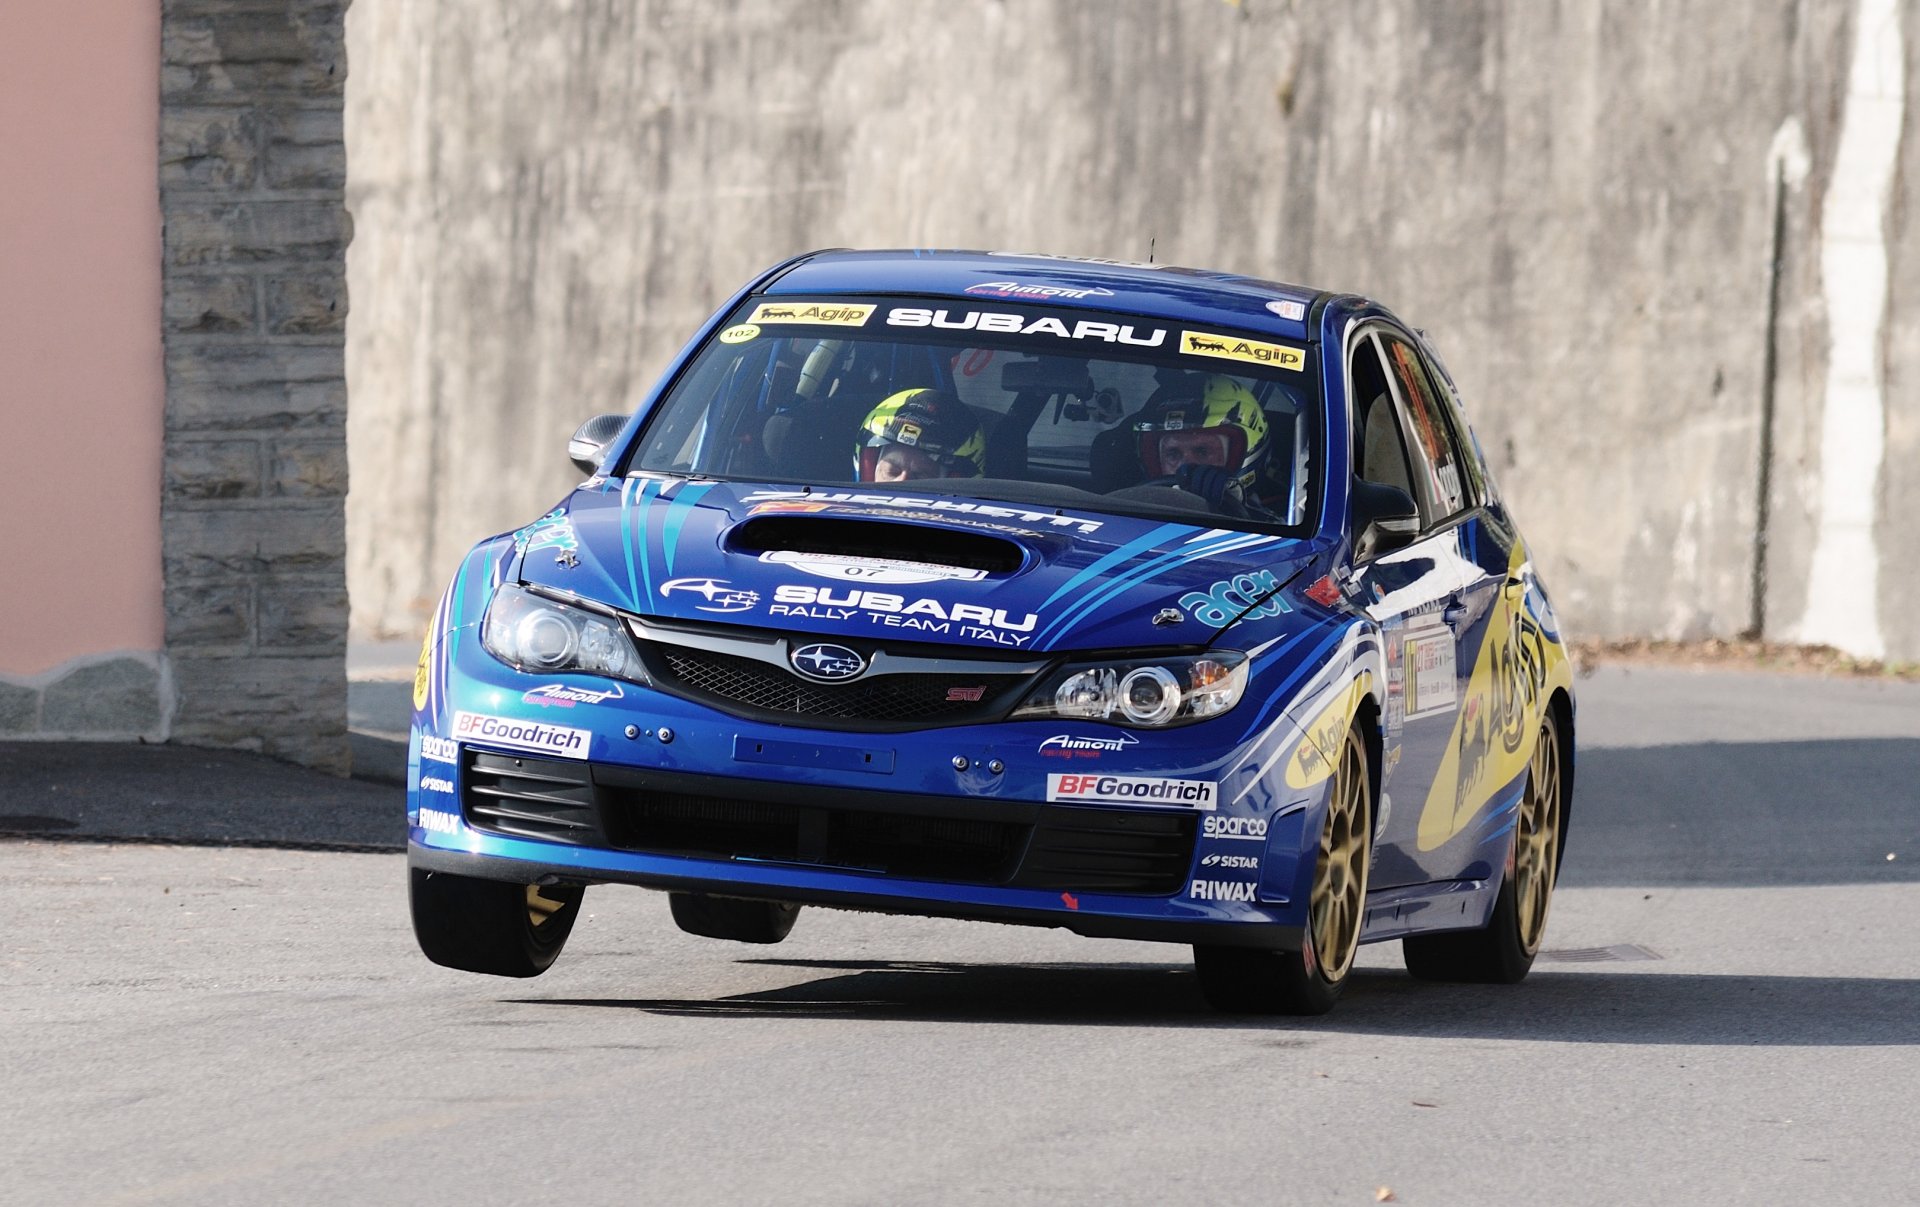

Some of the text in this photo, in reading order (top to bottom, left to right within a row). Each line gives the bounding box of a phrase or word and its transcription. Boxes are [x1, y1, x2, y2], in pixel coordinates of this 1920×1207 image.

[800, 306, 864, 321] Agip
[727, 329, 755, 339] 102
[886, 308, 1167, 347] SUBARU
[1232, 342, 1298, 364] Agip
[844, 567, 886, 577] 07
[773, 585, 1039, 632] SUBARU
[1178, 569, 1294, 629] acer
[769, 604, 1031, 647] RALLY TEAM ITALY
[522, 683, 624, 704] Aimont
[458, 714, 582, 749] BFGoodrich
[1037, 731, 1140, 753] Aimont
[1318, 716, 1345, 757] Agip
[429, 777, 454, 794] SISTAR
[1057, 775, 1211, 801] BFGoodrich
[419, 808, 460, 835] RIWAX
[1204, 815, 1267, 840] sparco
[1220, 855, 1259, 868] SISTAR
[1190, 880, 1258, 902] RIWAX
